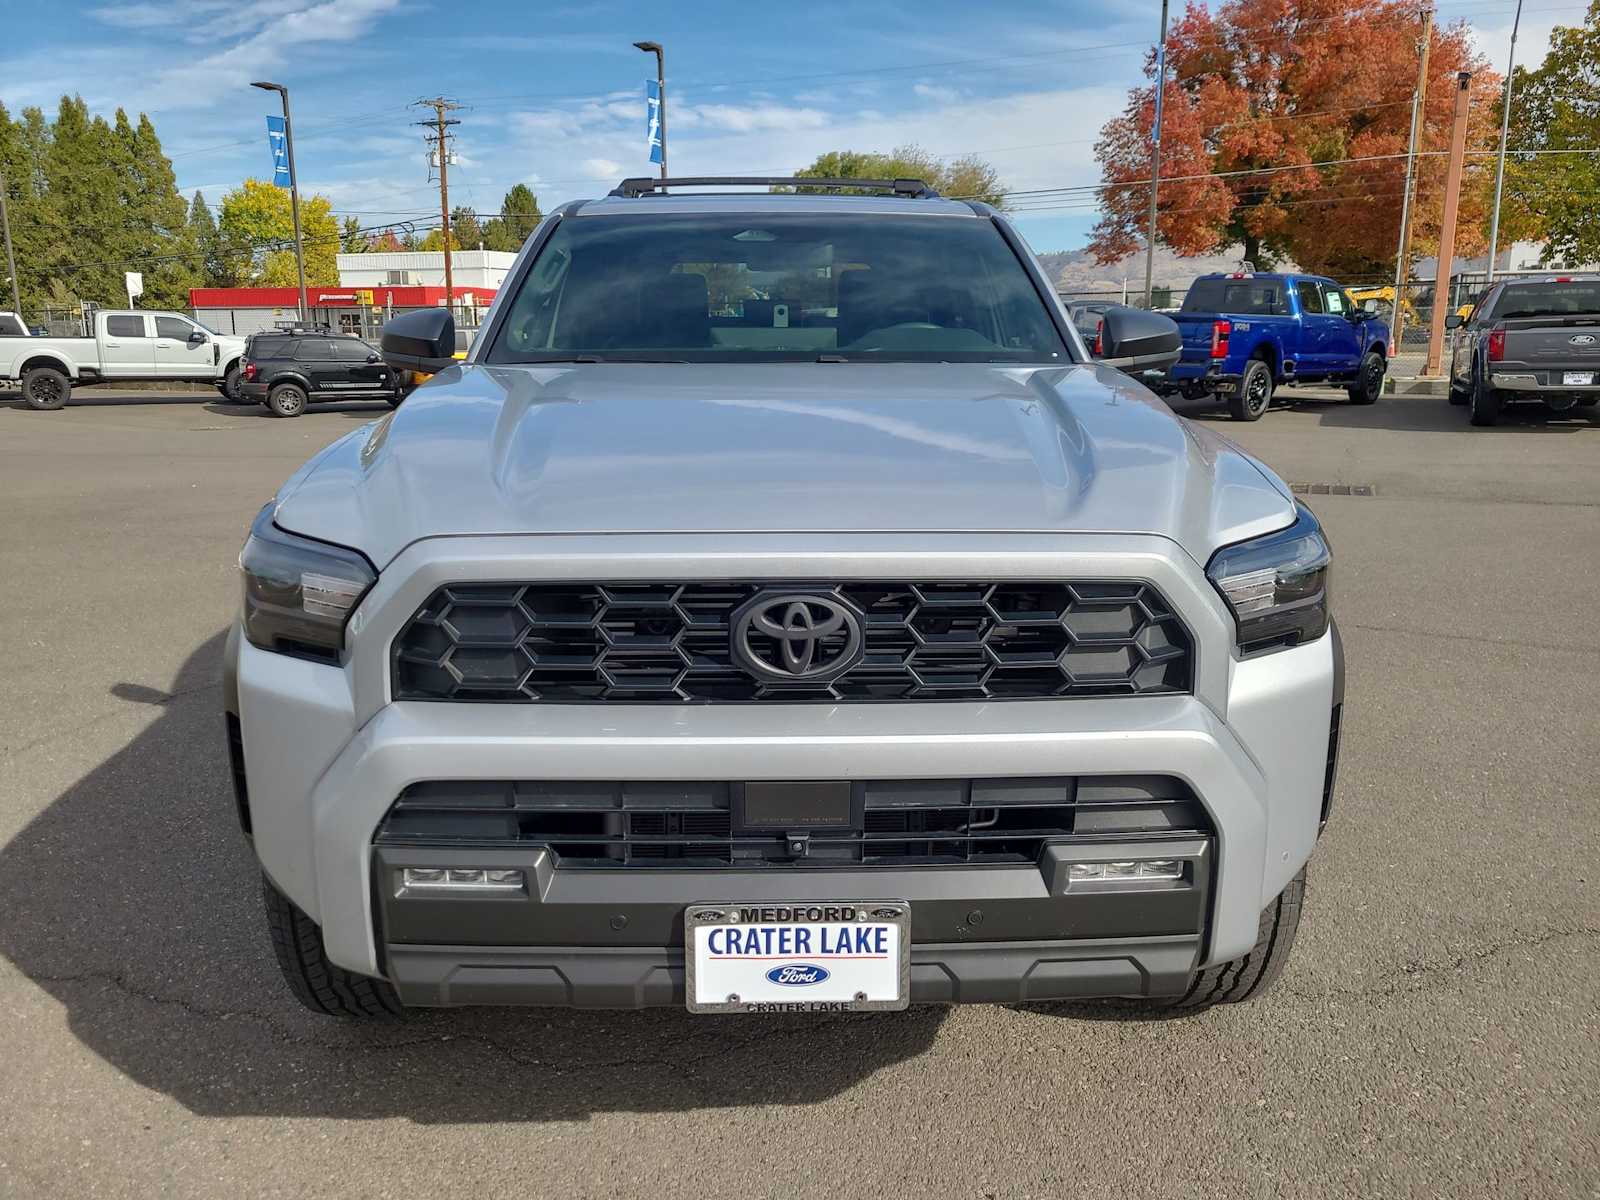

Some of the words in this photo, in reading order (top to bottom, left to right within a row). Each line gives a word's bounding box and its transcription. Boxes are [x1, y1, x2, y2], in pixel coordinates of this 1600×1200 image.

[740, 907, 856, 922] MEDFORD
[708, 927, 812, 954] CRATER
[821, 927, 888, 954] LAKE
[778, 966, 817, 984] Ford
[746, 1003, 805, 1013] CRATER
[810, 1002, 850, 1012] LAKE
